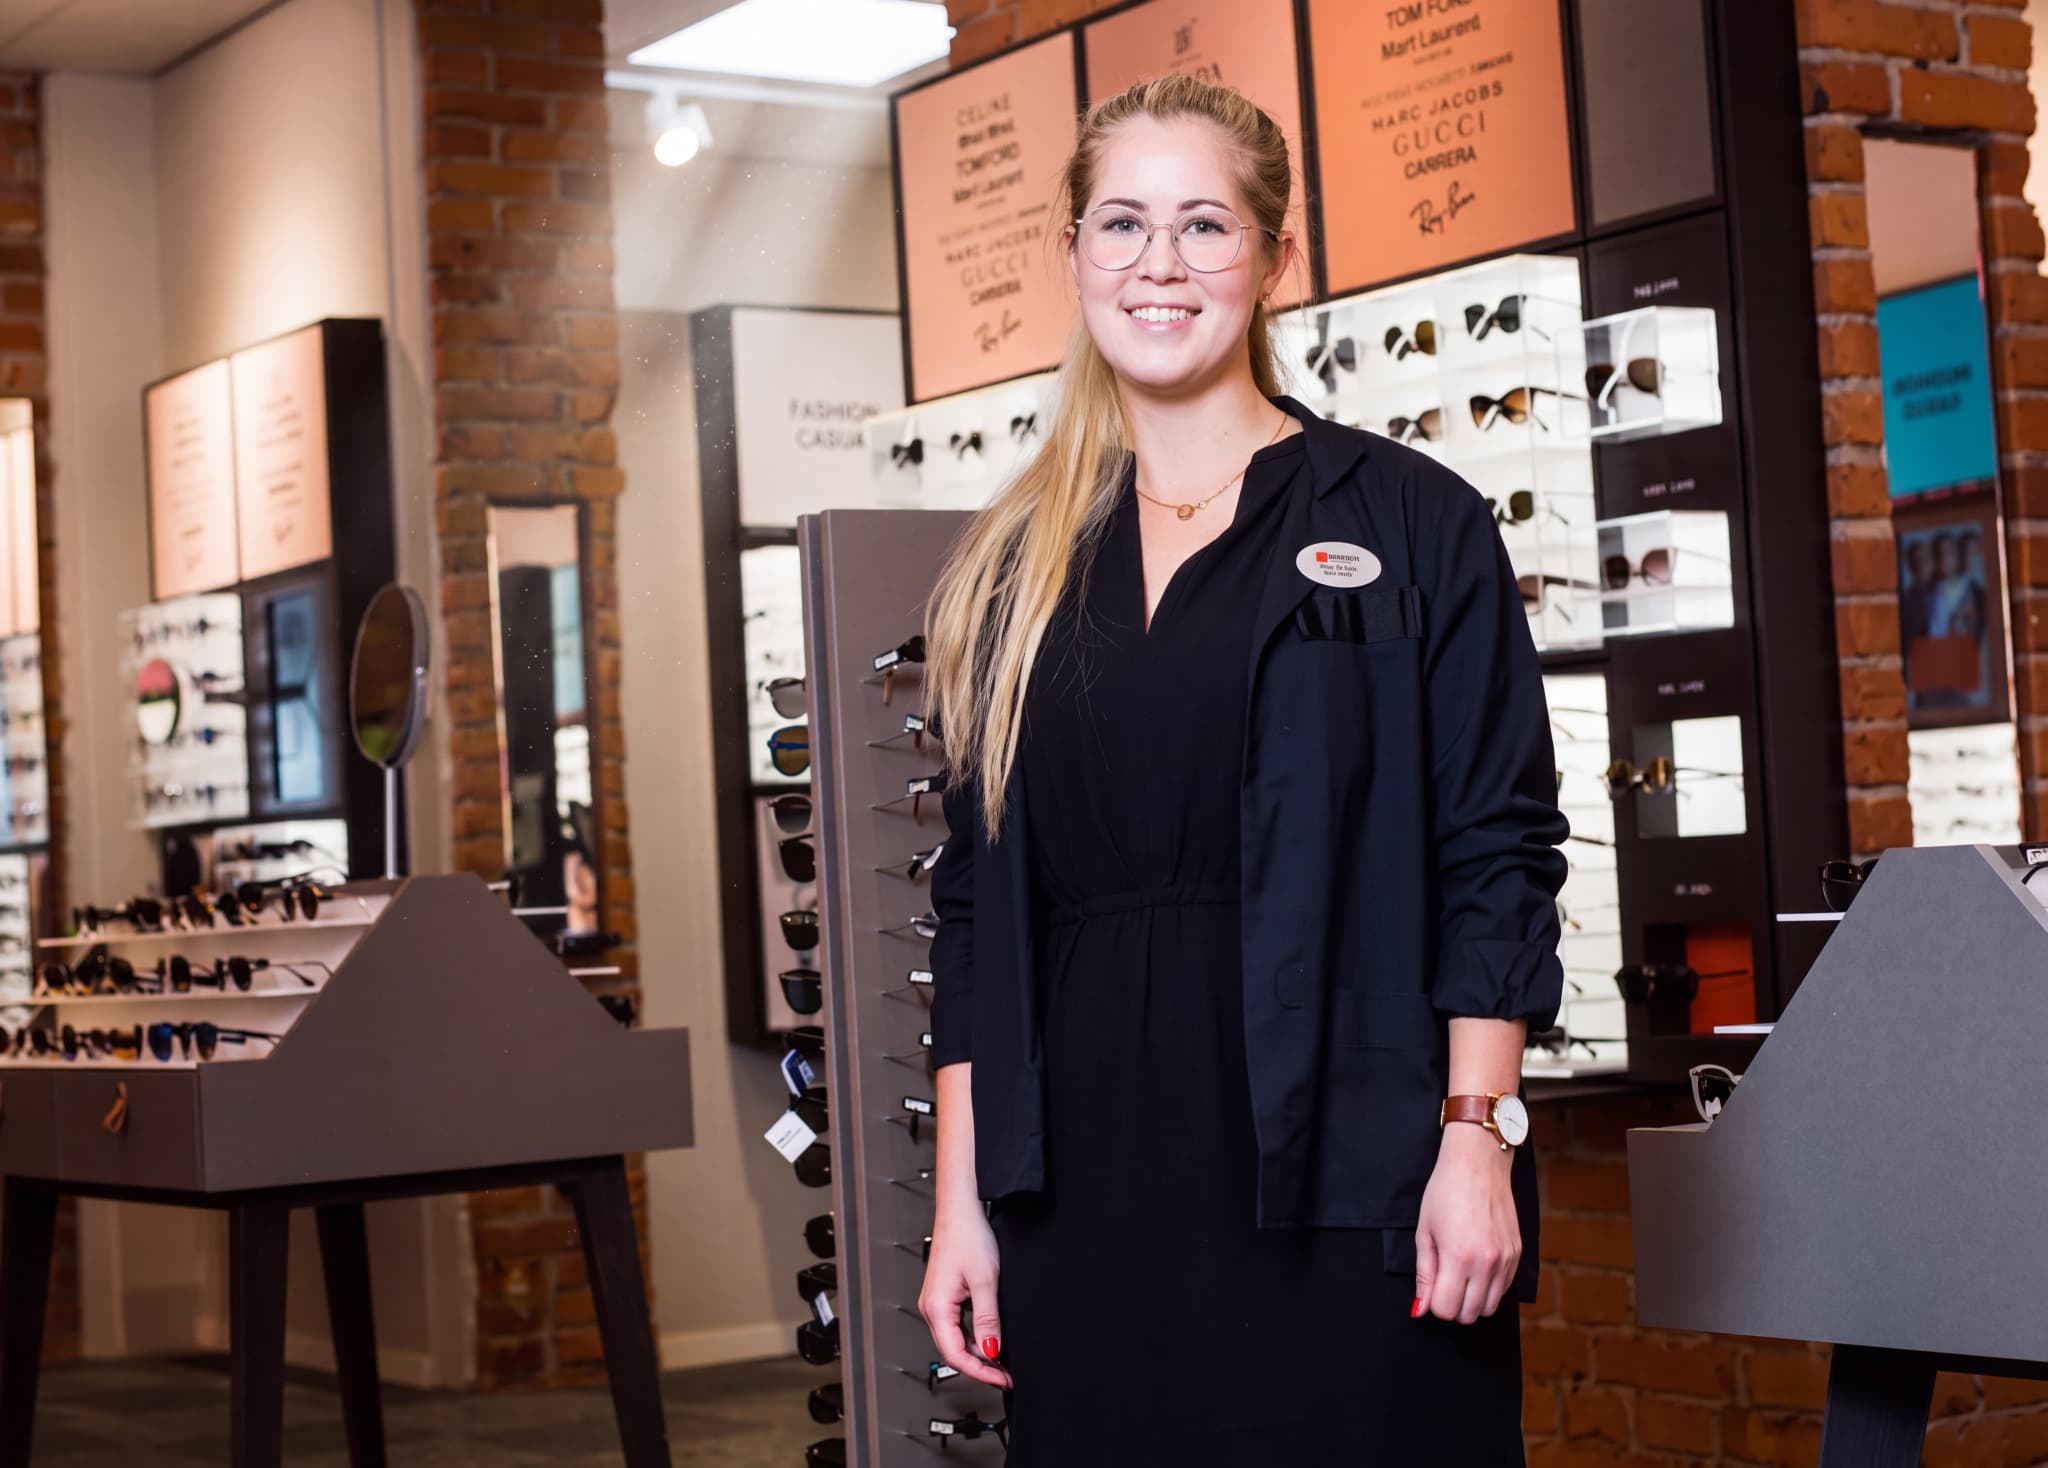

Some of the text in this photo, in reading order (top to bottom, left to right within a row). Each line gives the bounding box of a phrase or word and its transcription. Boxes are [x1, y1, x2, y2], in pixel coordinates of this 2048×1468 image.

[1386, 1, 1422, 30] TOM
[1372, 104, 1421, 132] MARC
[1428, 79, 1504, 117] JACOBS
[1392, 110, 1486, 156] GUCCI
[1403, 145, 1477, 179] CARRERA
[788, 400, 881, 420] FASHION
[797, 427, 864, 450] CASUA
